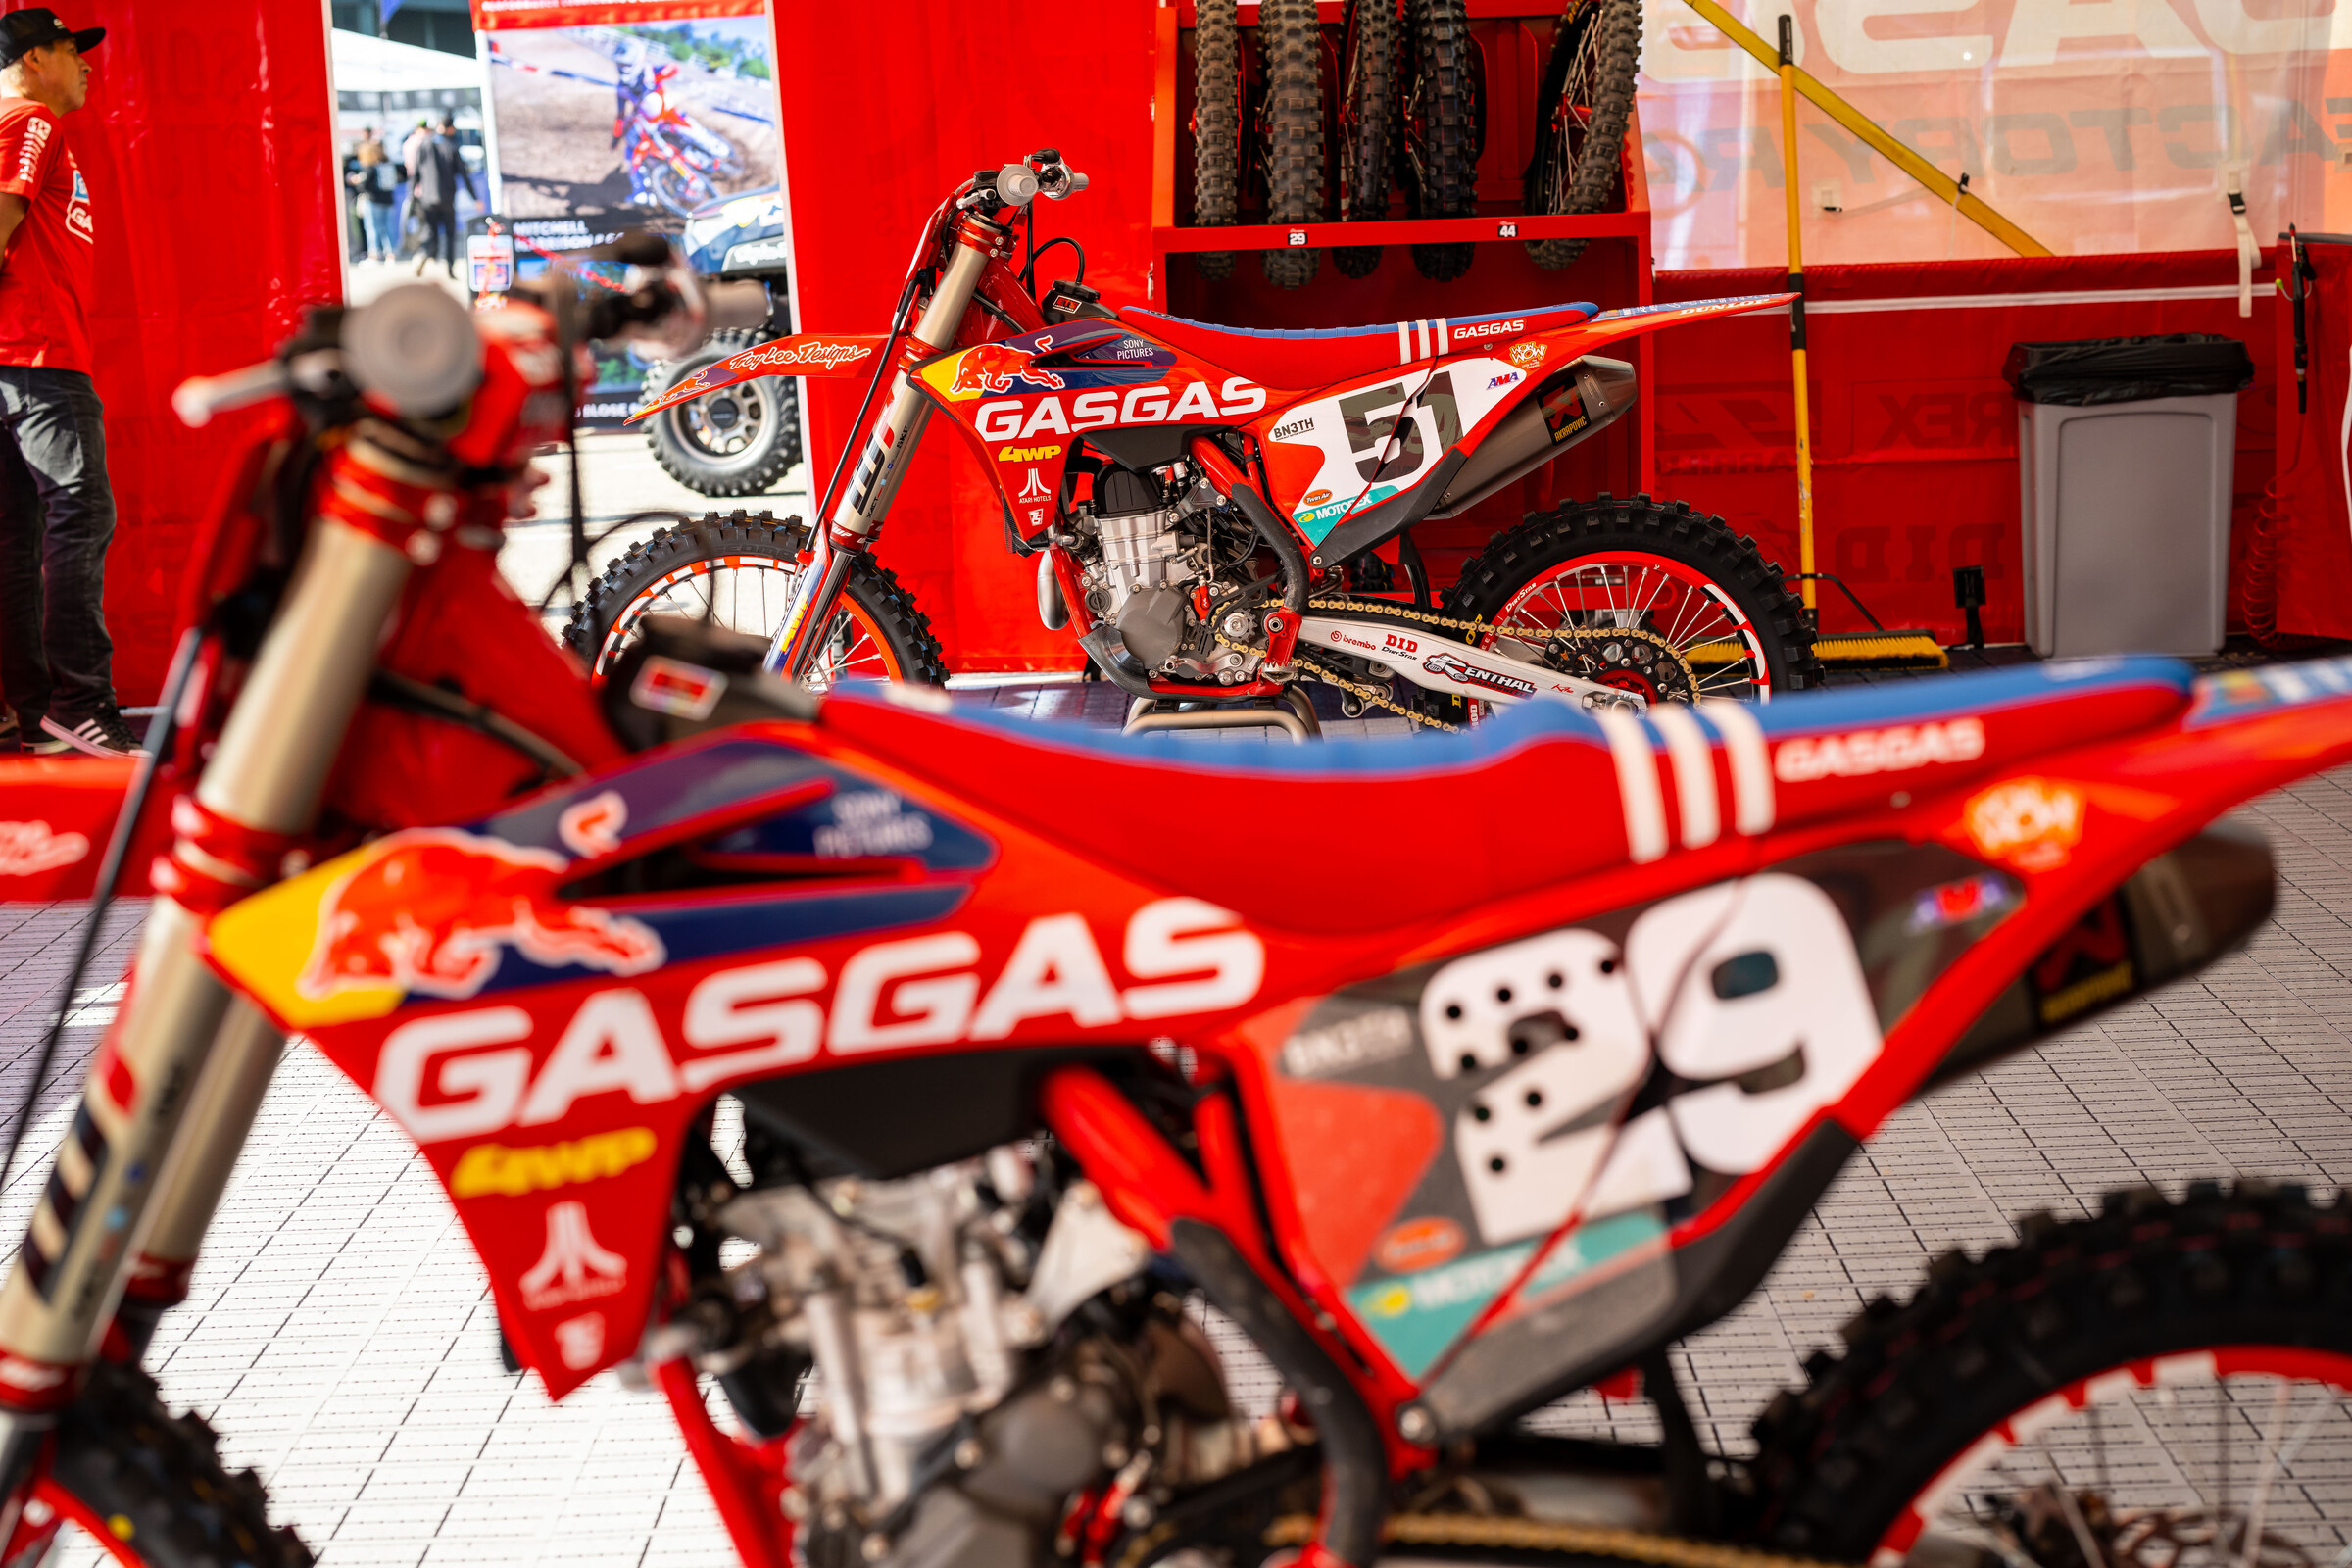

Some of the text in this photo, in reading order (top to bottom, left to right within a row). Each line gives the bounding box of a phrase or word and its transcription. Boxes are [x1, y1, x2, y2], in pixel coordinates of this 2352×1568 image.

[1499, 224, 1516, 237] 44
[1055, 297, 1079, 309] ETS
[1679, 298, 1770, 315] DUNLOP
[1453, 319, 1524, 339] GASGAS
[1117, 347, 1153, 360] PICTURES
[1123, 339, 1144, 349] SONY
[763, 346, 798, 364] Lee
[798, 342, 871, 369] Designs
[1487, 371, 1519, 389] AMA
[975, 376, 1267, 442] GASGAS
[896, 424, 908, 449] SKF
[1273, 417, 1314, 439] BN3TH
[1339, 371, 1465, 484] 51
[998, 444, 1062, 463] 4WP
[1018, 494, 1052, 505] ATARI HOTELS
[1305, 491, 1331, 504] Twin Air
[1343, 634, 1377, 651] brembo
[1385, 633, 1418, 654] D.I.D
[1424, 653, 1535, 694] RENTHAL
[1774, 716, 1986, 783] GASGAS
[373, 895, 1265, 1145] GASGAS
[1418, 871, 1885, 1248] 29
